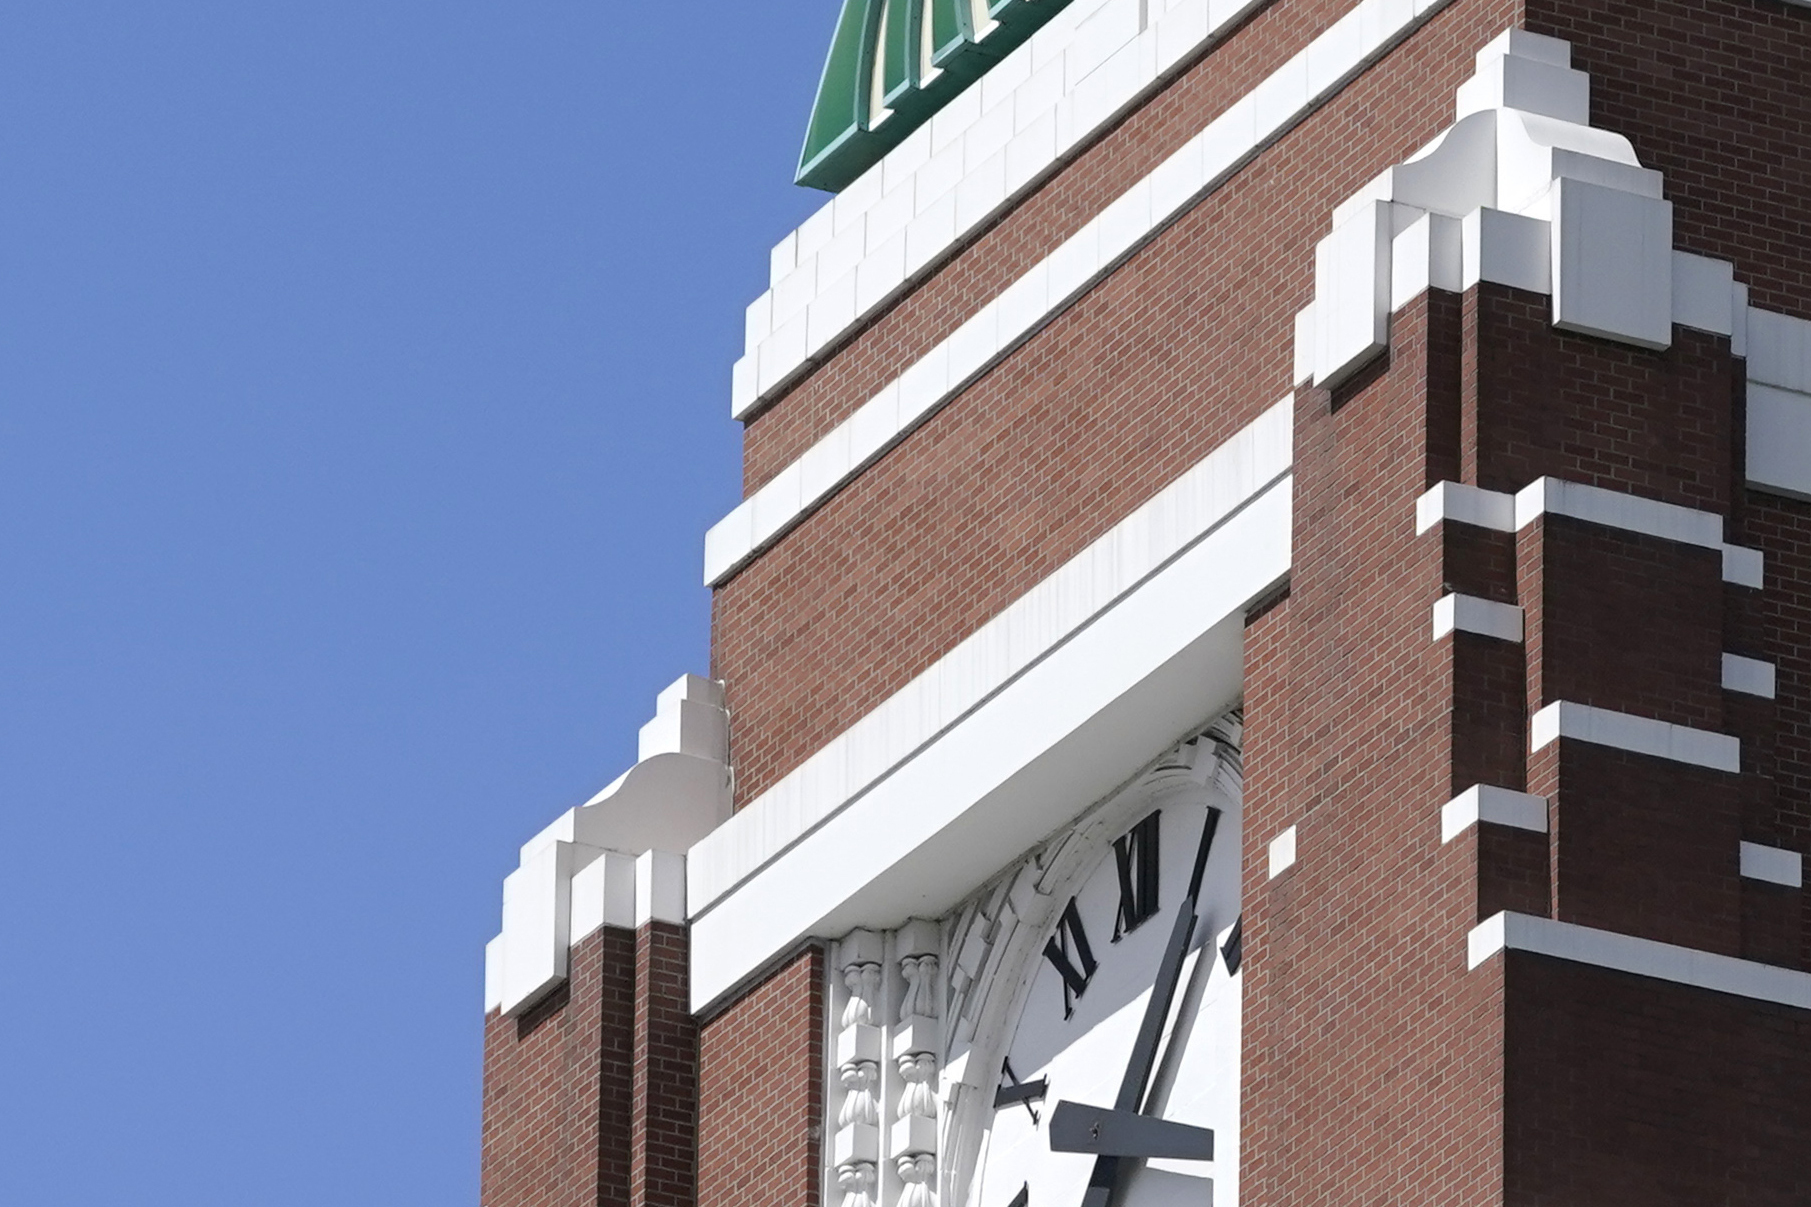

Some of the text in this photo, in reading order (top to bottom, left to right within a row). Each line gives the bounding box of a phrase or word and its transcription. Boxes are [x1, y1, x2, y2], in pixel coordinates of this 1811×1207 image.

[1110, 808, 1162, 944] XII
[1042, 895, 1099, 1021] XI
[993, 1056, 1048, 1127] X
